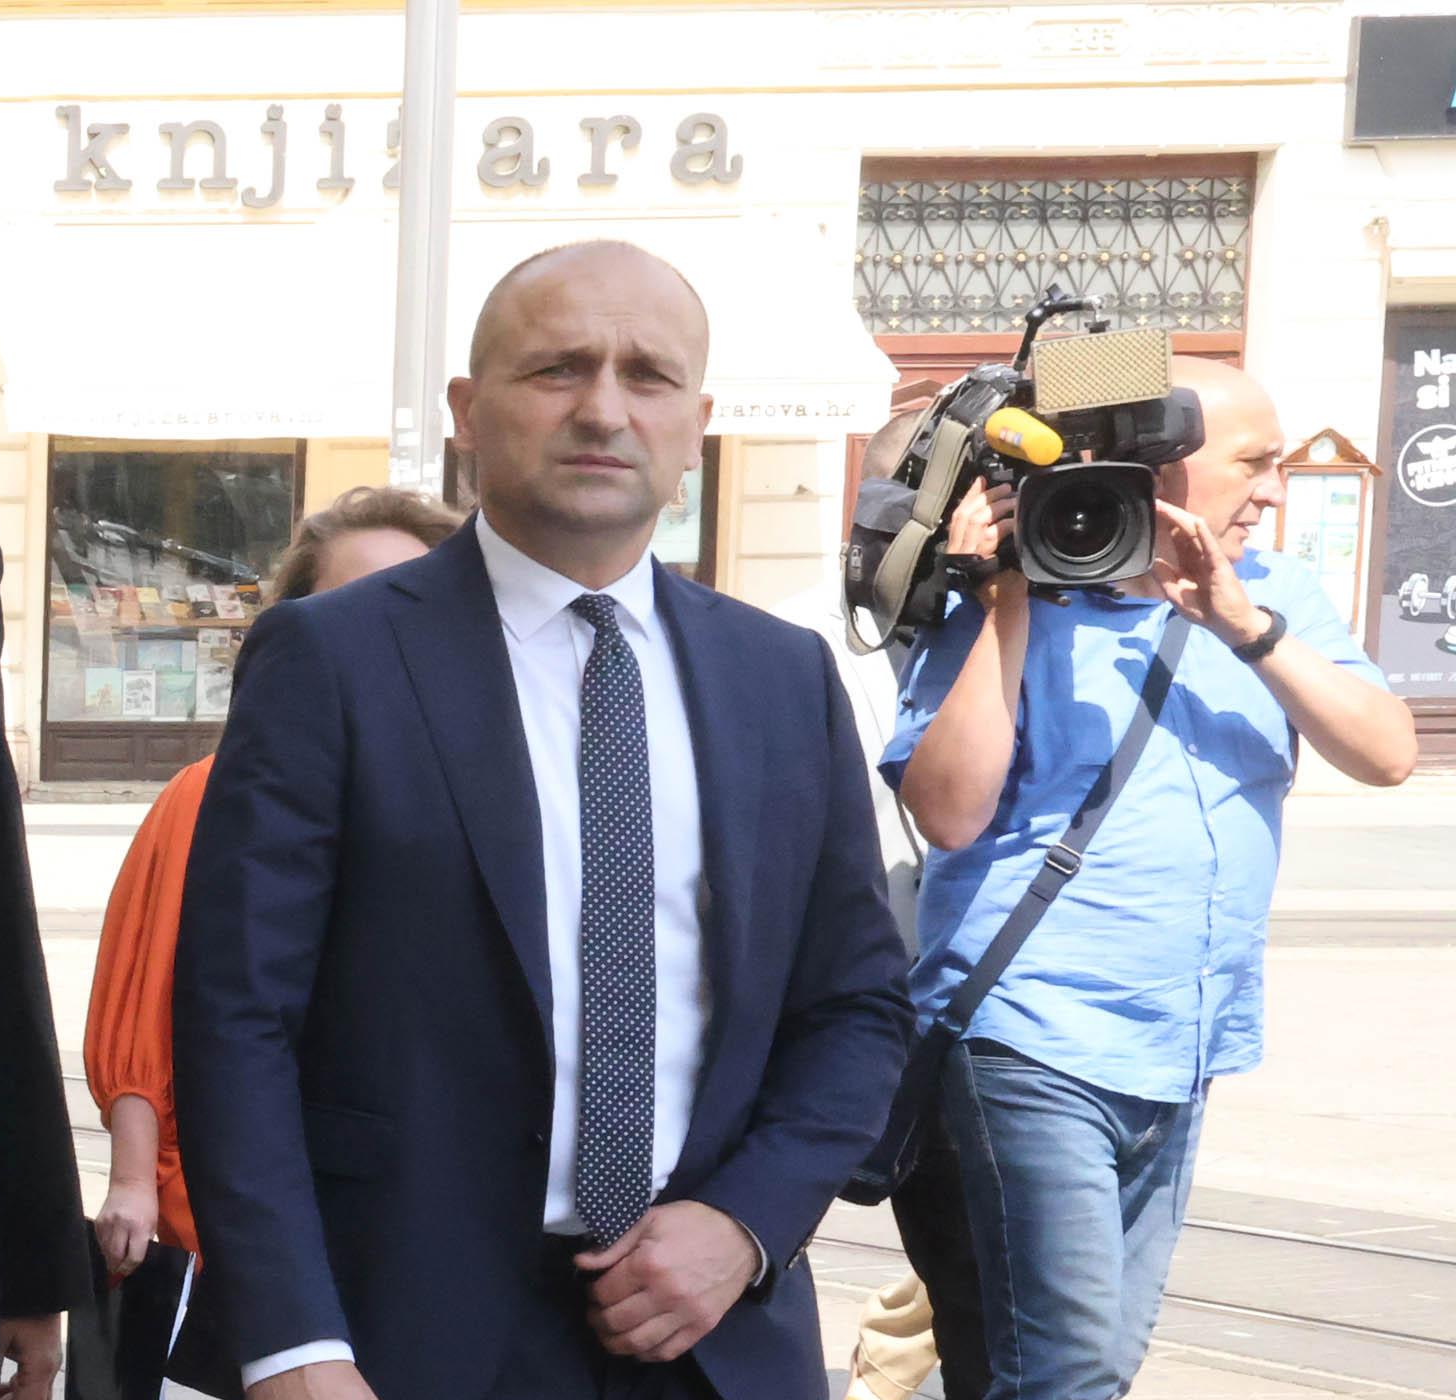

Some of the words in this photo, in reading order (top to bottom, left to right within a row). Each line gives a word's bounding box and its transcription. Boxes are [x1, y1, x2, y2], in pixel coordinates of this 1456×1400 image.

[54, 104, 744, 208] knjiara
[715, 400, 856, 417] ranova.hr
[1416, 374, 1450, 410] si
